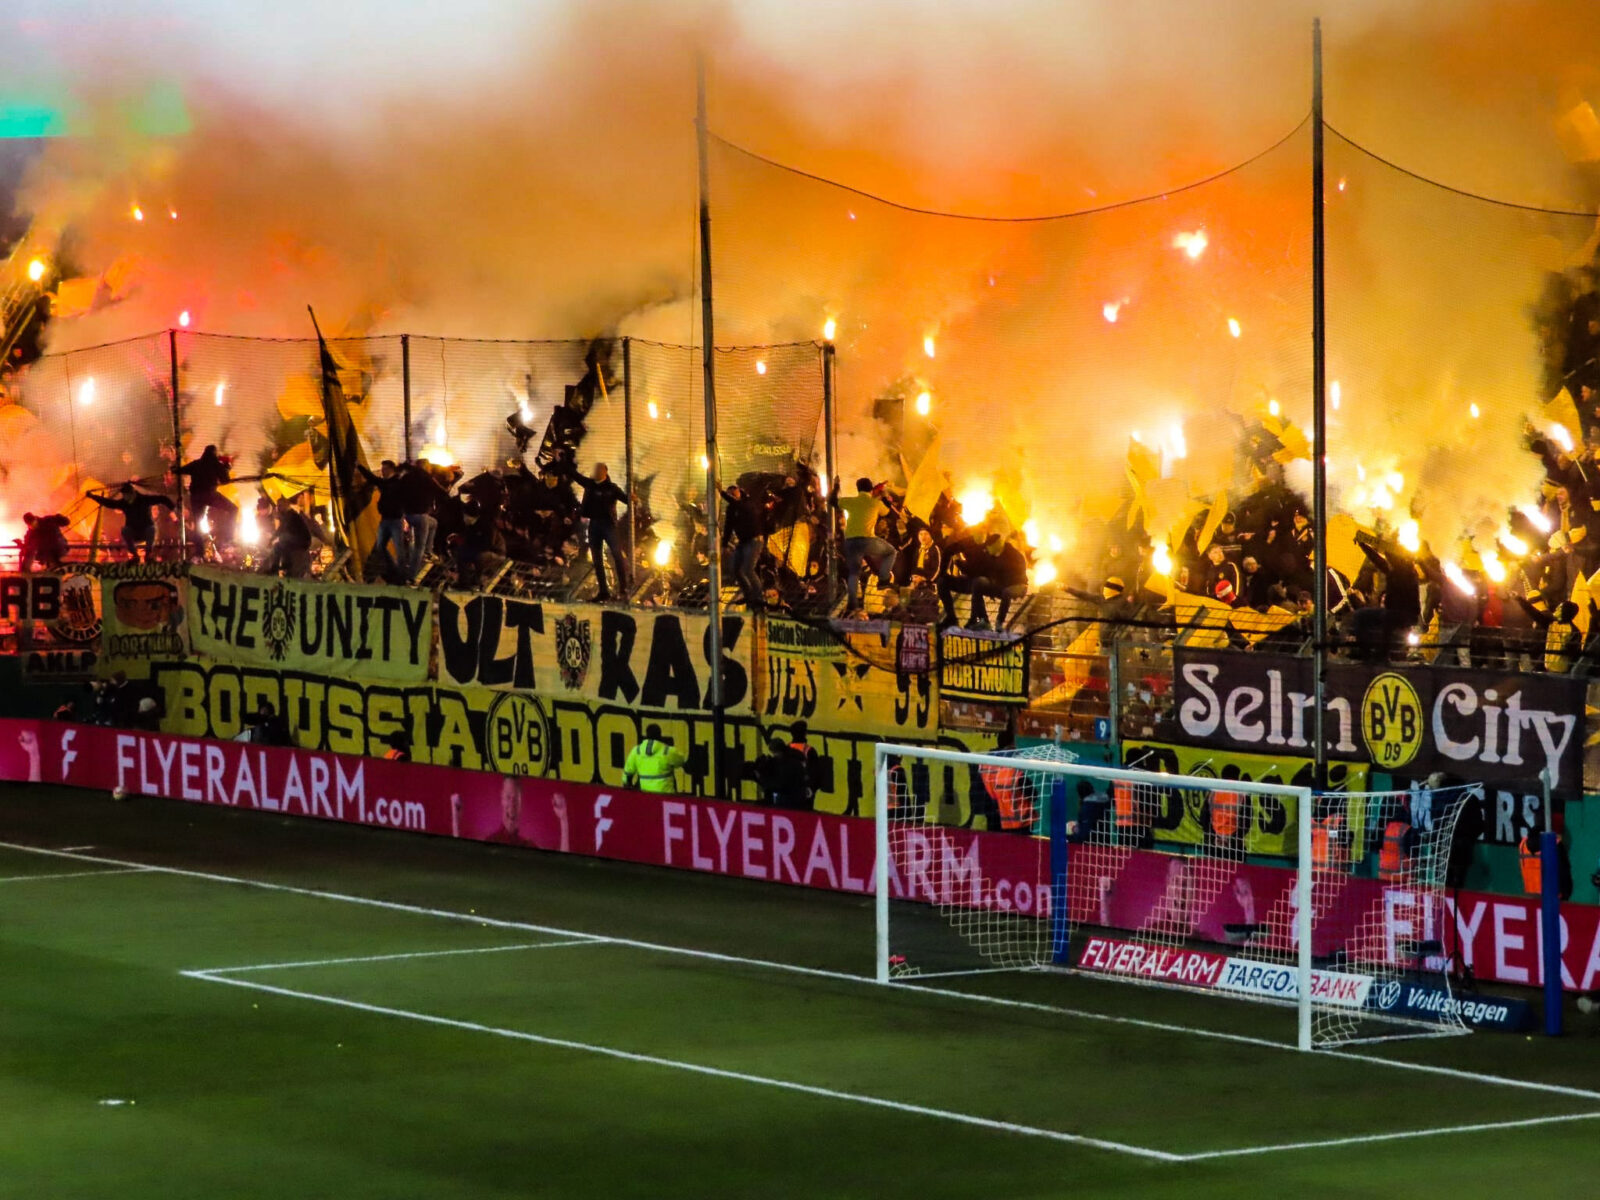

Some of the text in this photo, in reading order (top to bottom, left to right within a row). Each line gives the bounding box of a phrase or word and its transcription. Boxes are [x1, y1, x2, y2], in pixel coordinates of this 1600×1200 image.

[191, 575, 427, 666] THE UNITY
[943, 663, 1024, 694] DORTMUND
[497, 701, 543, 762] BVB
[1099, 720, 1107, 733] 9
[1179, 663, 1577, 789] Selm City
[1370, 683, 1417, 744] BVB
[1384, 743, 1402, 762] 09
[116, 734, 427, 831] FLYERALARM.com
[1081, 939, 1221, 983] FLYERALARM
[1406, 987, 1509, 1023] Volkswagen
